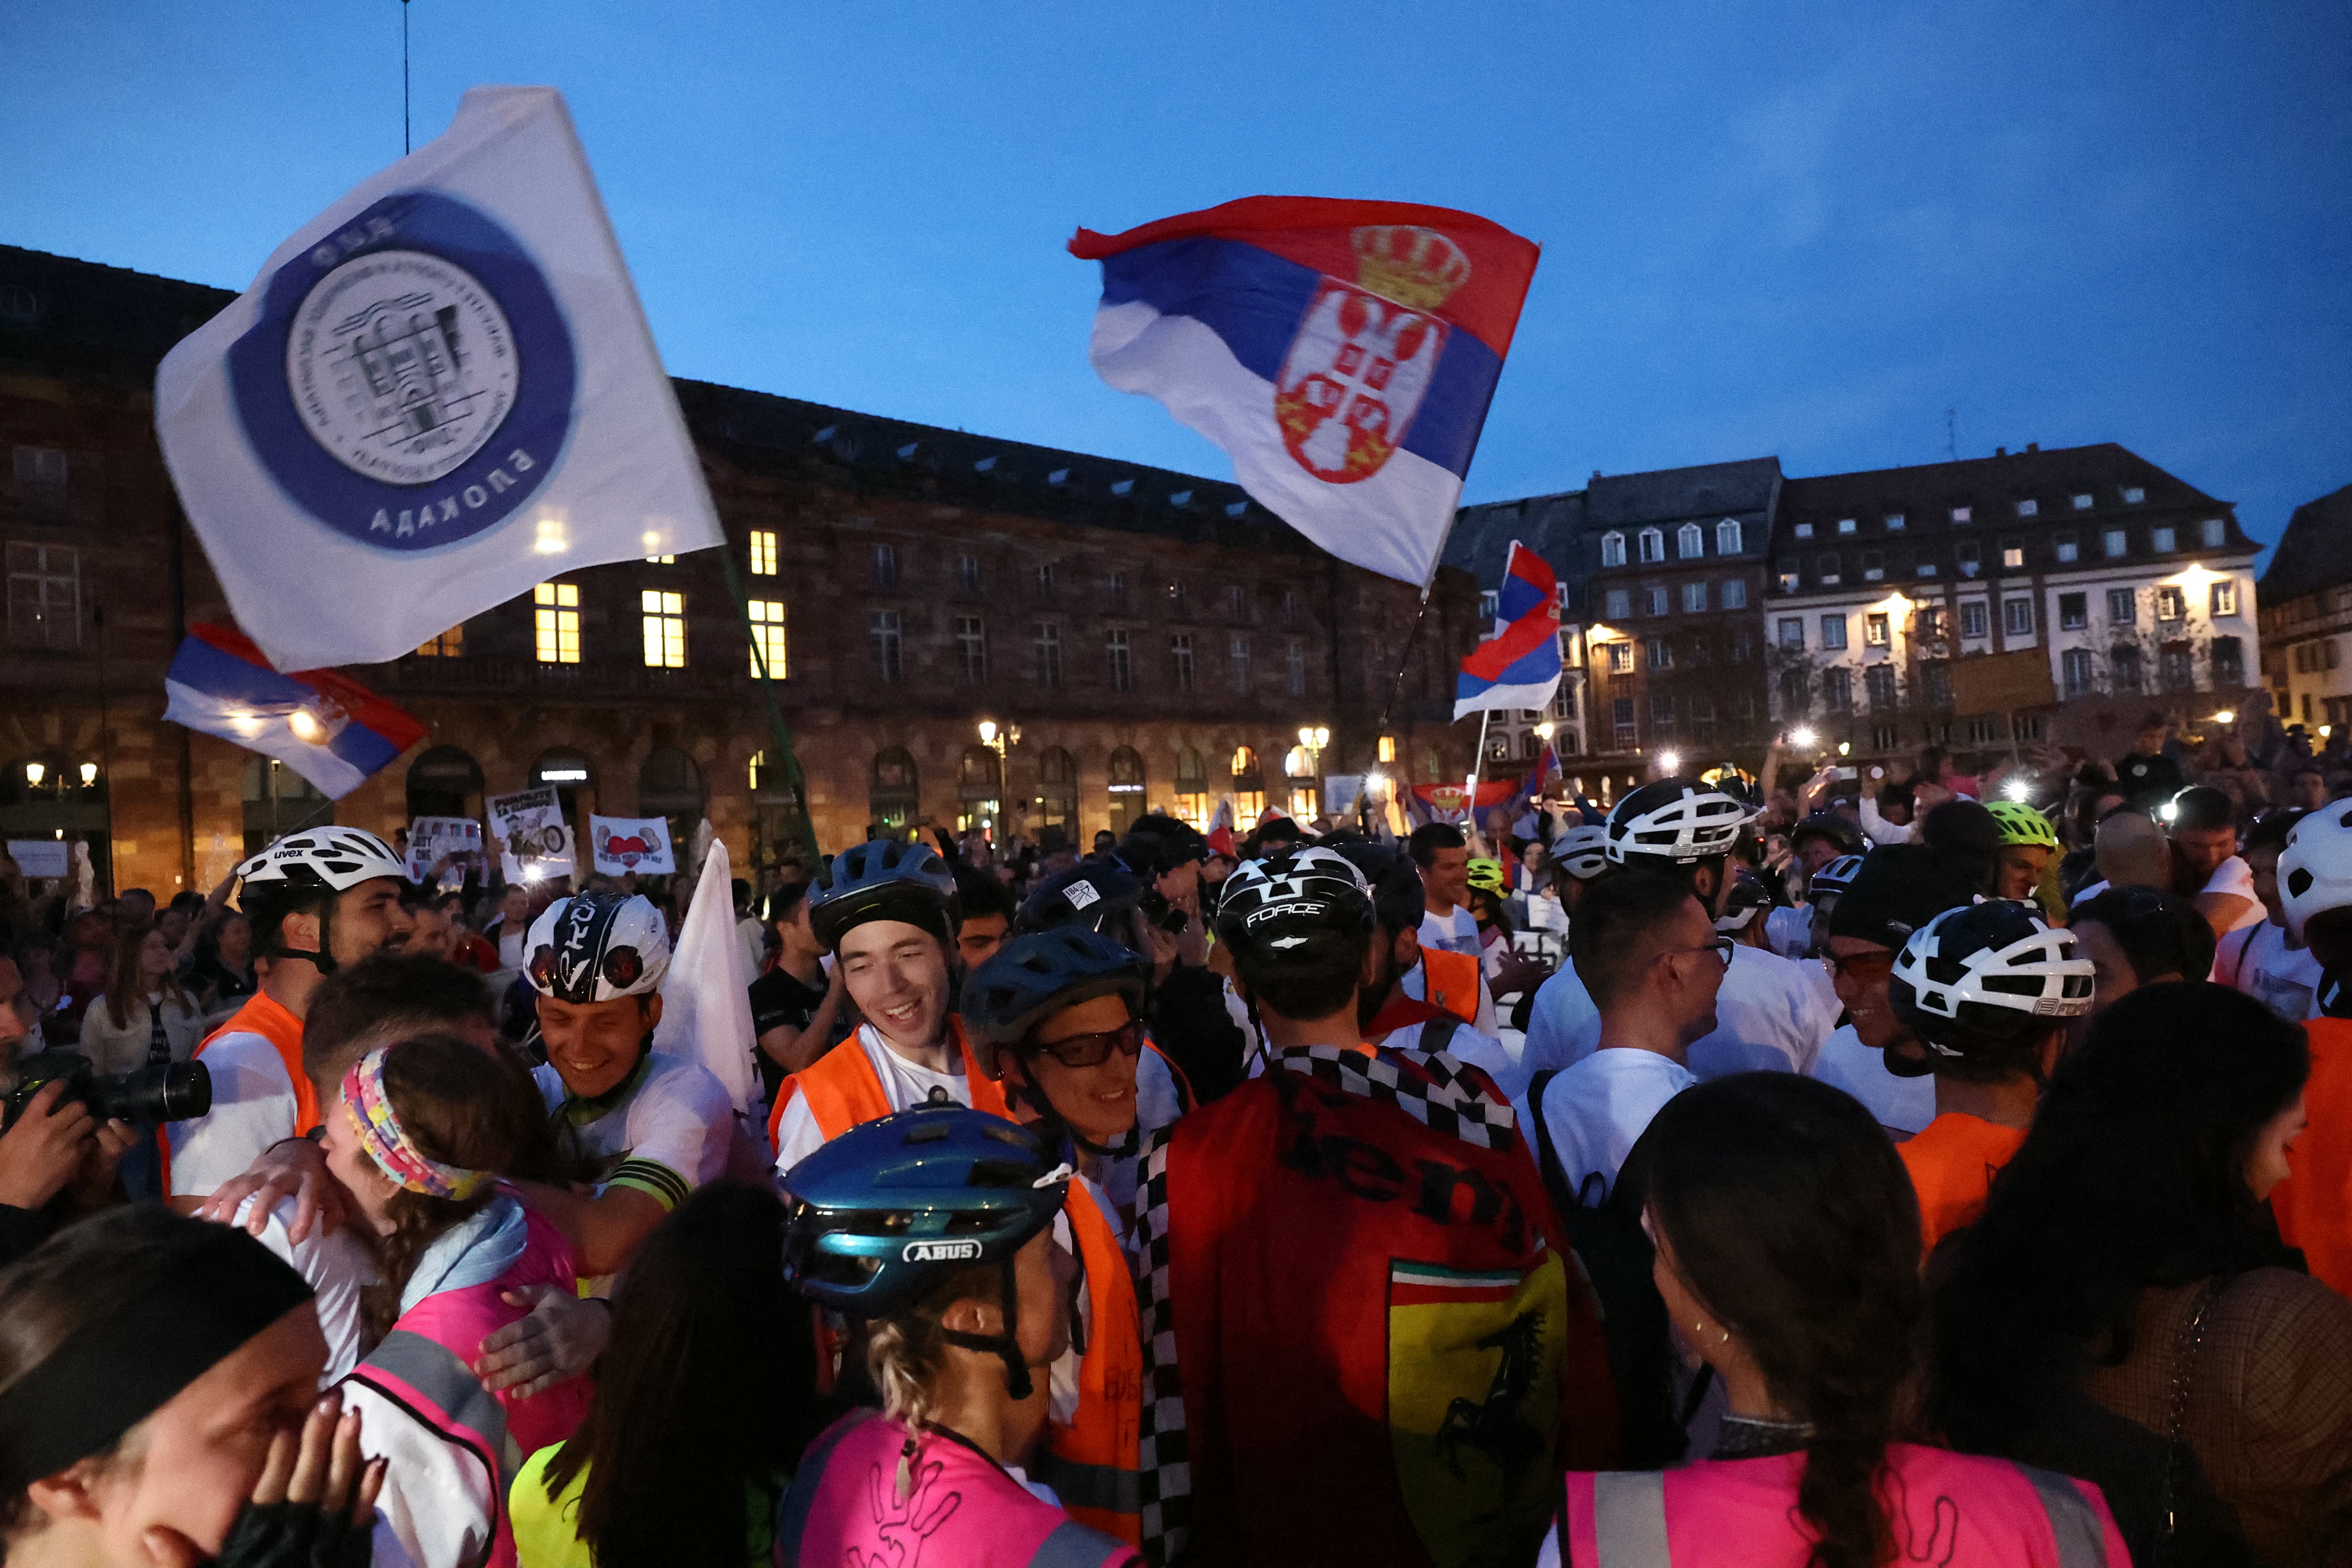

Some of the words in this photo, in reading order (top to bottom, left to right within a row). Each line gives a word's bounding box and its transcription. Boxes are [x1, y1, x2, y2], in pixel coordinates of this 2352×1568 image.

[274, 849, 303, 859] uvex
[1065, 886, 1079, 897] 184
[1247, 903, 1325, 928] FORCE
[913, 1243, 973, 1261] ABUS
